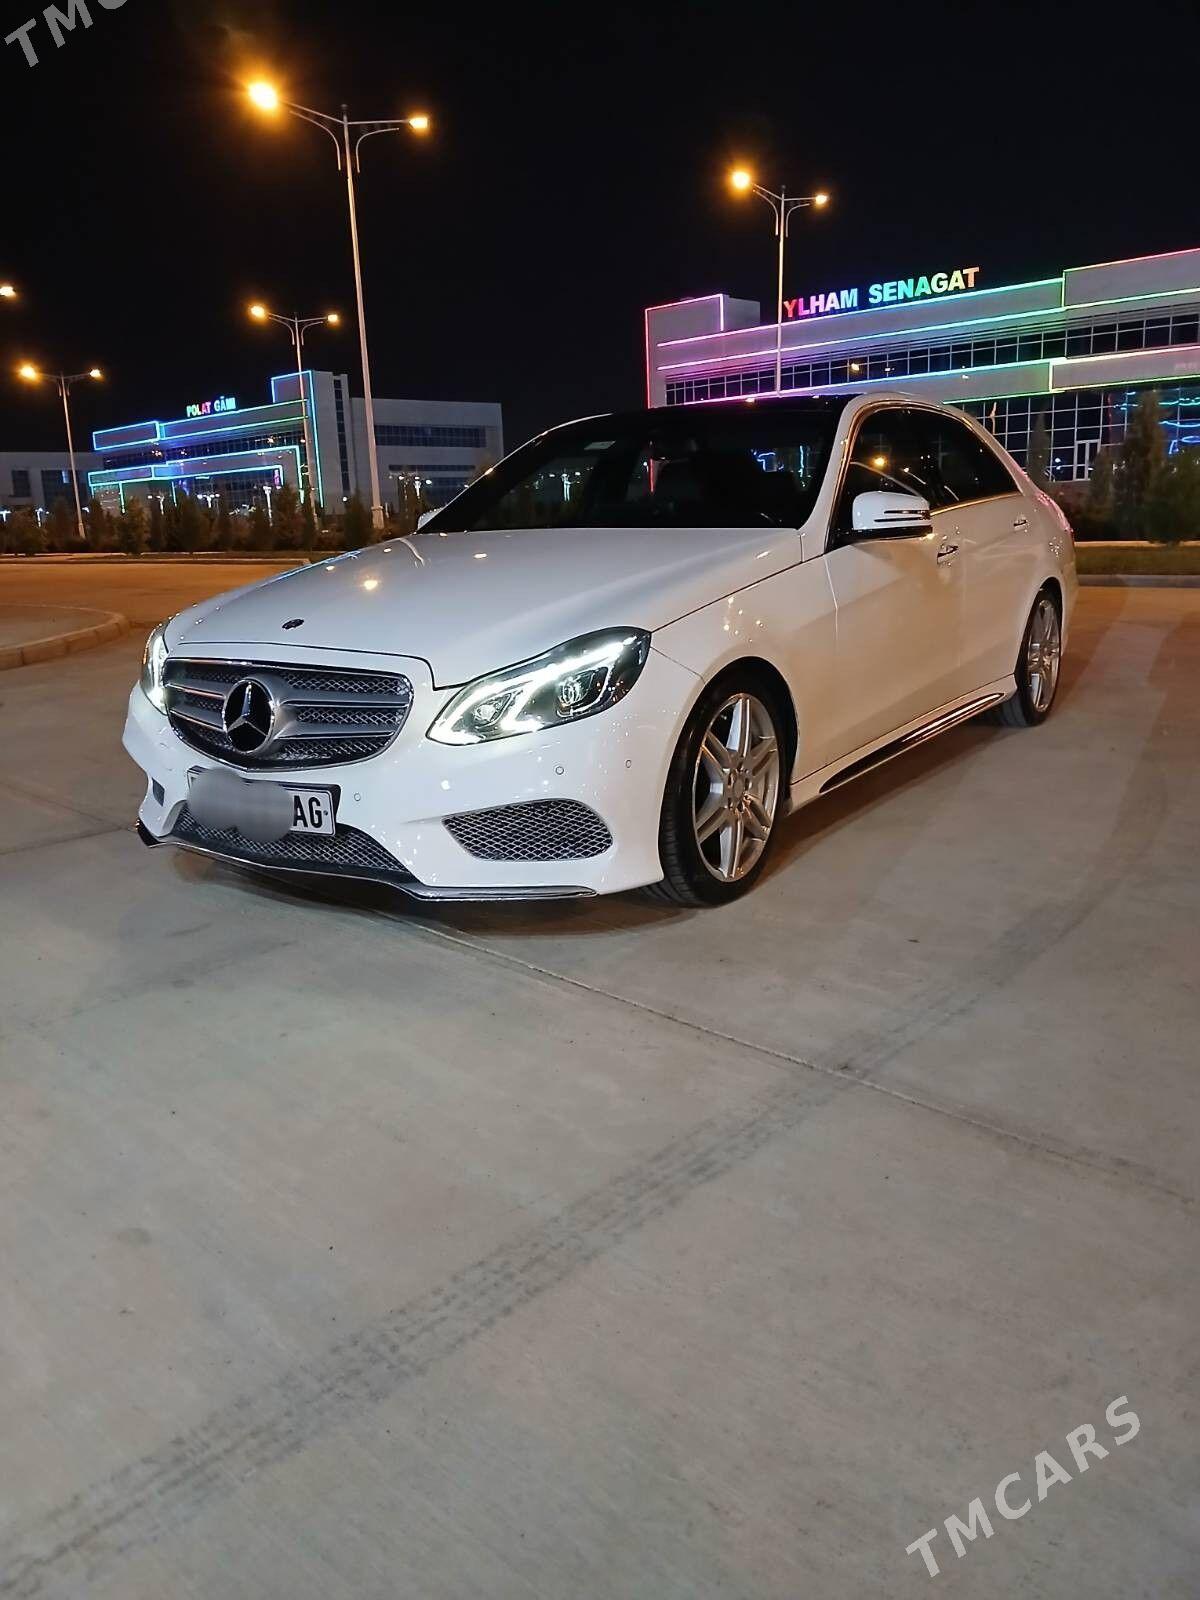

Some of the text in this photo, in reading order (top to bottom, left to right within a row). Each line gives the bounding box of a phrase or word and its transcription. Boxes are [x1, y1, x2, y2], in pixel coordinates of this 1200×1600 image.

[783, 267, 980, 318] YLHAM SENAGAT
[186, 401, 211, 417] POLAT
[293, 795, 323, 829] AG
